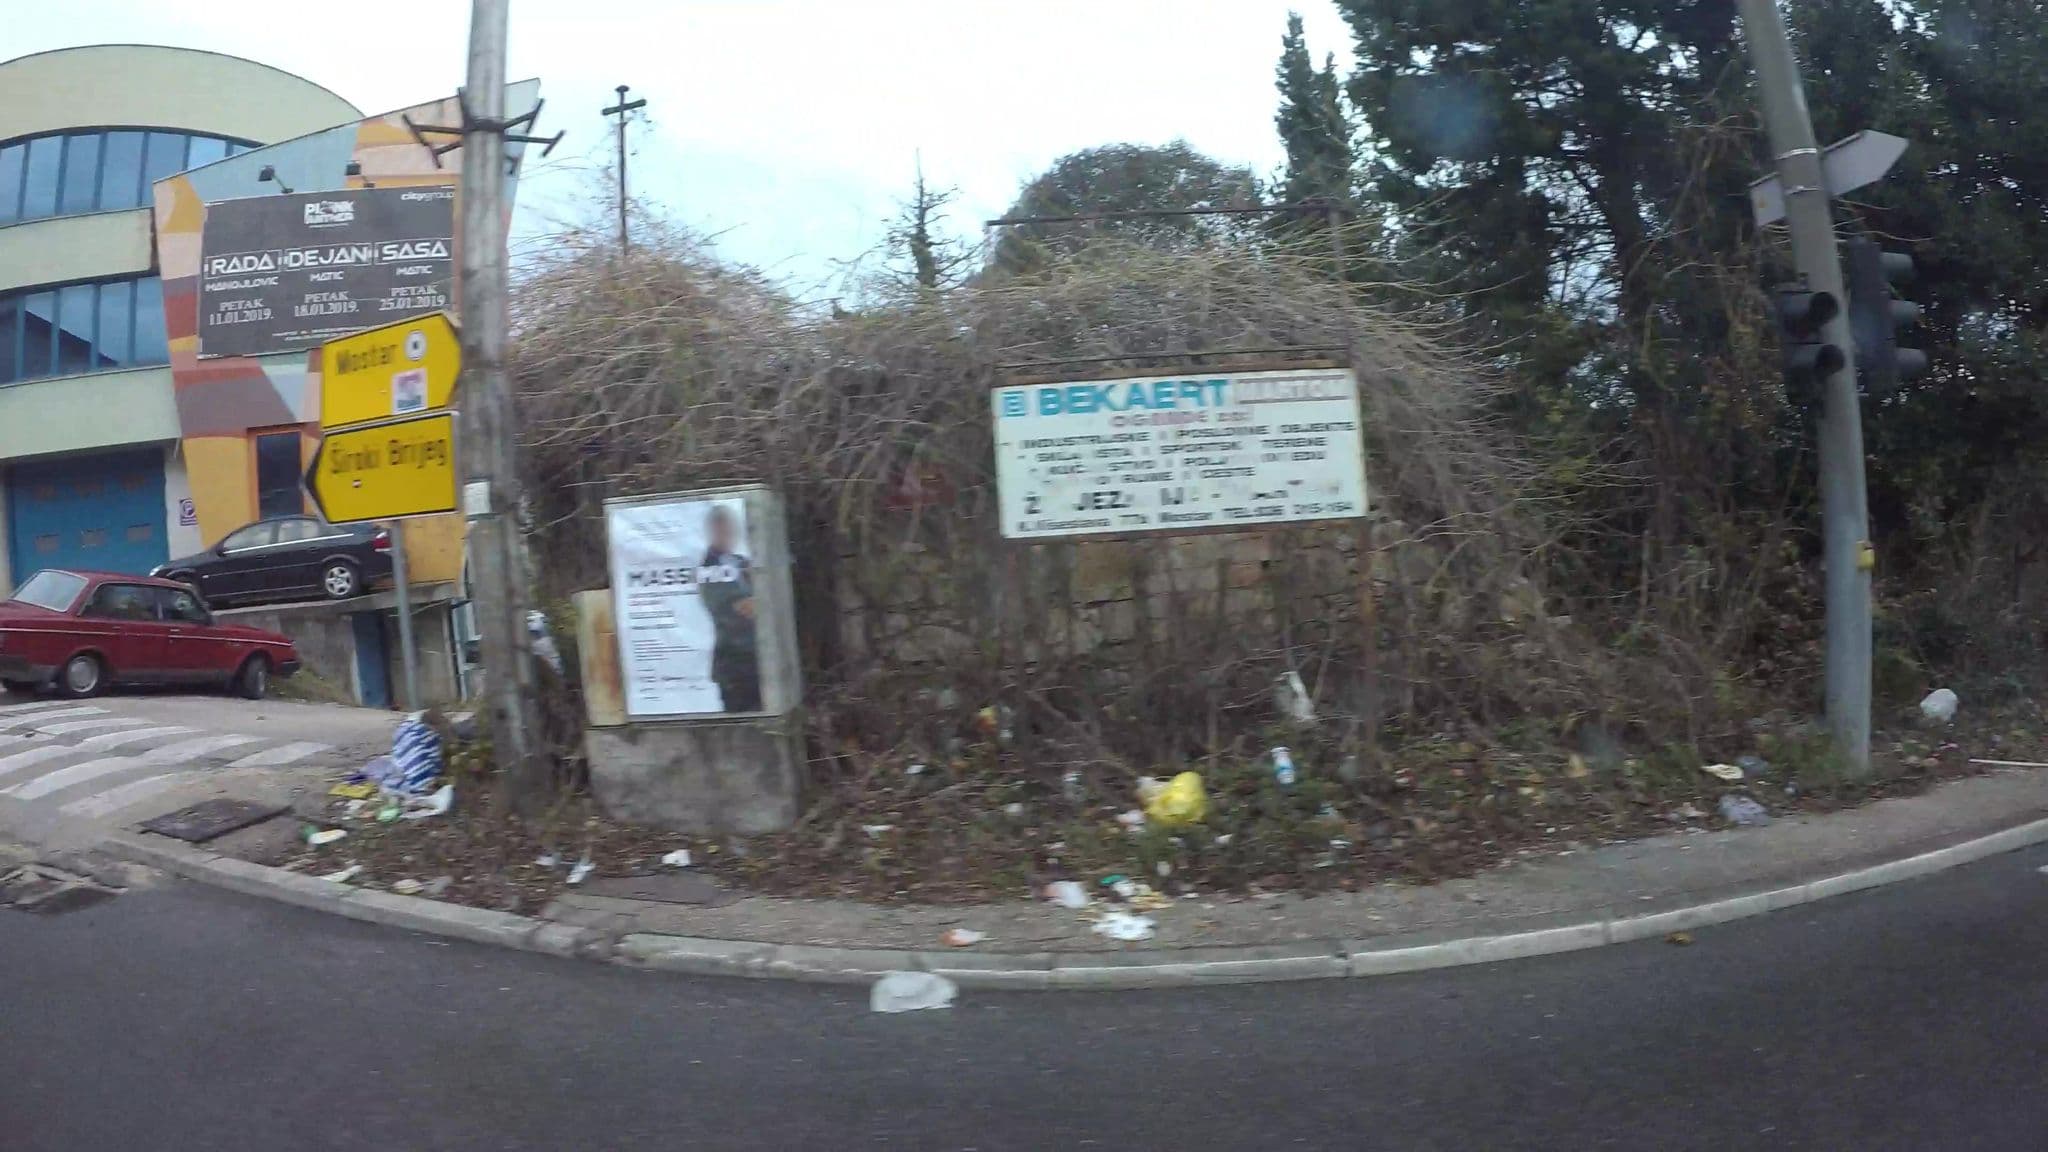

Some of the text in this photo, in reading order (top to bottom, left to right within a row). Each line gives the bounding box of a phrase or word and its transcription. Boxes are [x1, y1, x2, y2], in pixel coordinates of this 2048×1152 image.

[288, 245, 369, 267] DEJAN
[382, 241, 449, 261] SASA
[211, 253, 276, 275] RADA
[396, 264, 433, 276] MATIC
[310, 270, 345, 282] MATIC
[304, 291, 350, 304] PETAK
[390, 284, 440, 297] PETAK
[219, 299, 265, 312] PETAK
[337, 344, 398, 376] Mostar
[1037, 378, 1229, 417] BEKAERT
[1280, 421, 1357, 435] OBJEKTE
[388, 436, 447, 470] Brijeg
